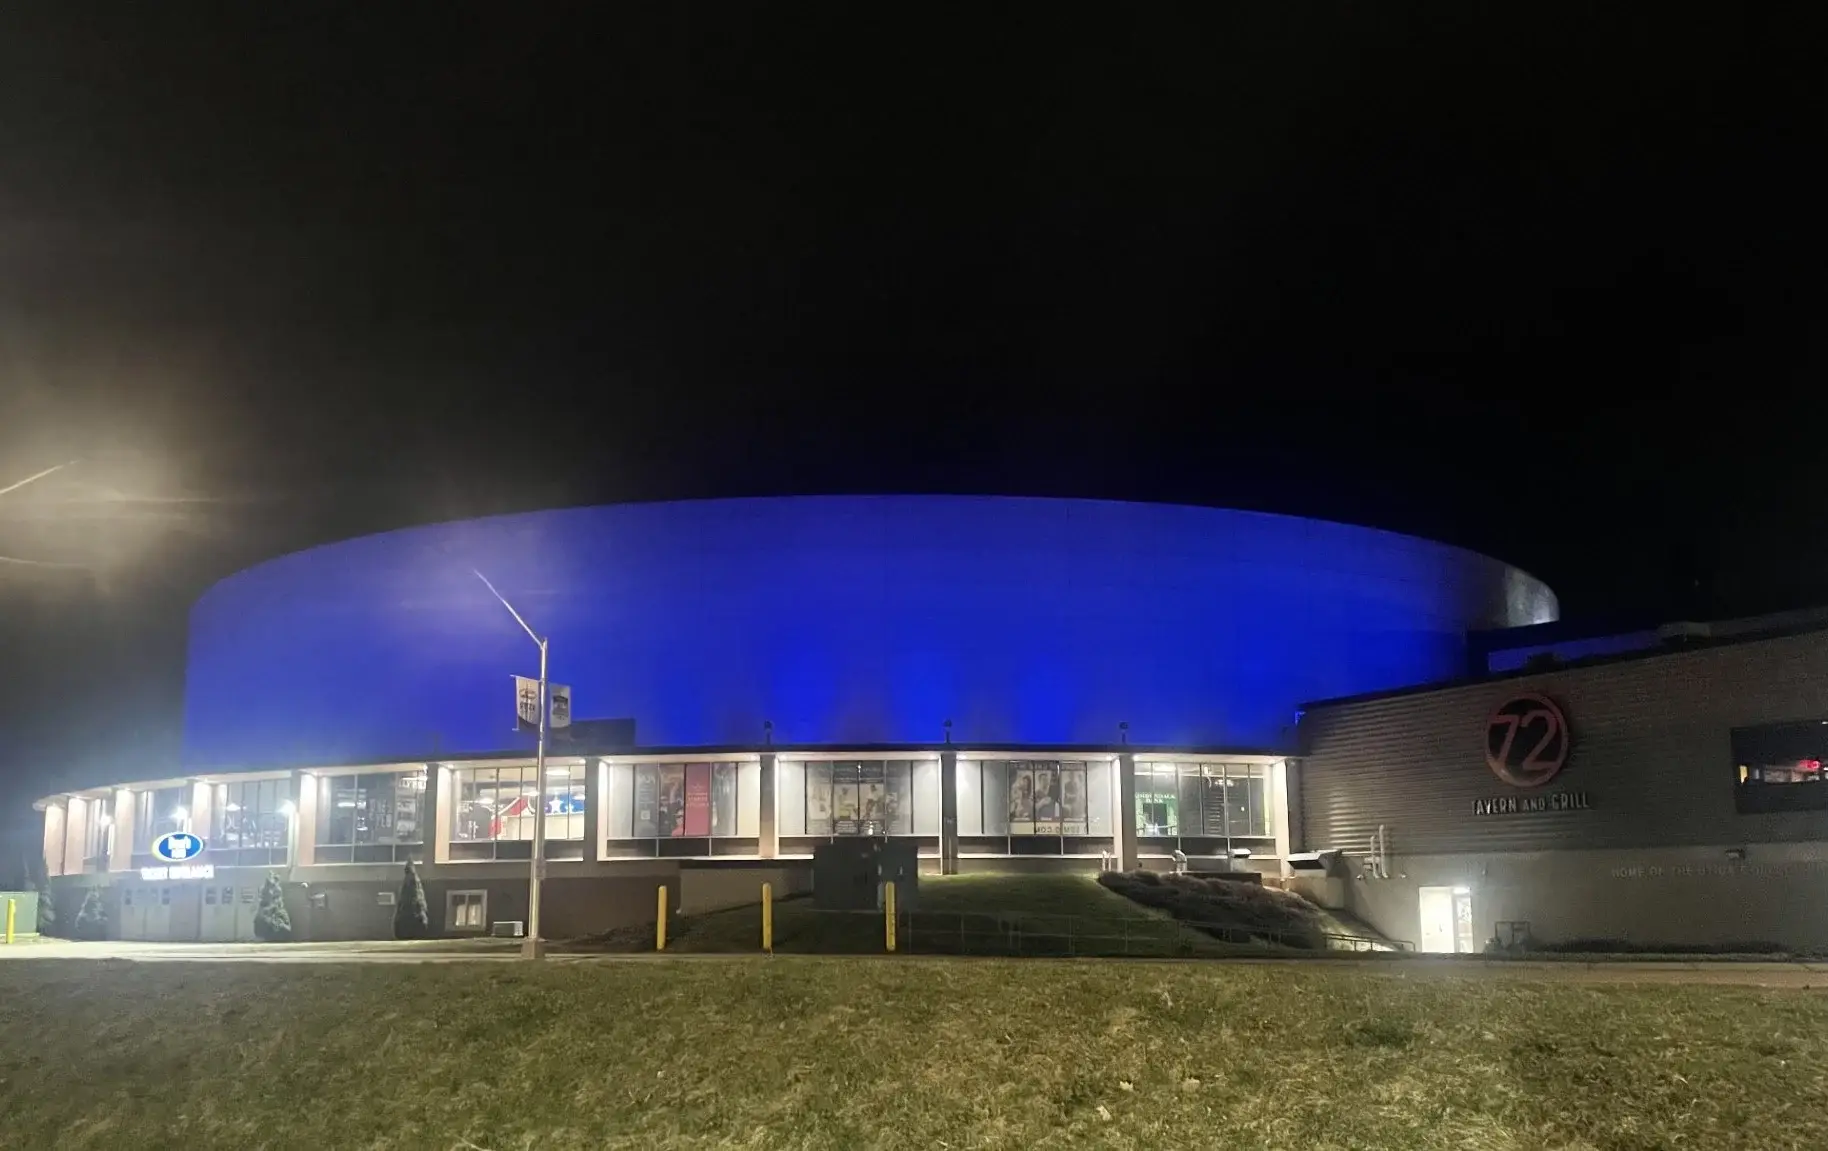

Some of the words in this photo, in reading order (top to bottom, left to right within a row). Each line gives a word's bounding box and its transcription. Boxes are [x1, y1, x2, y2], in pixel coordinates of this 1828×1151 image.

[1488, 709, 1560, 770] 72
[1471, 797, 1517, 815] TAVERN
[1523, 798, 1546, 812] AND
[1552, 791, 1590, 810] GRILL
